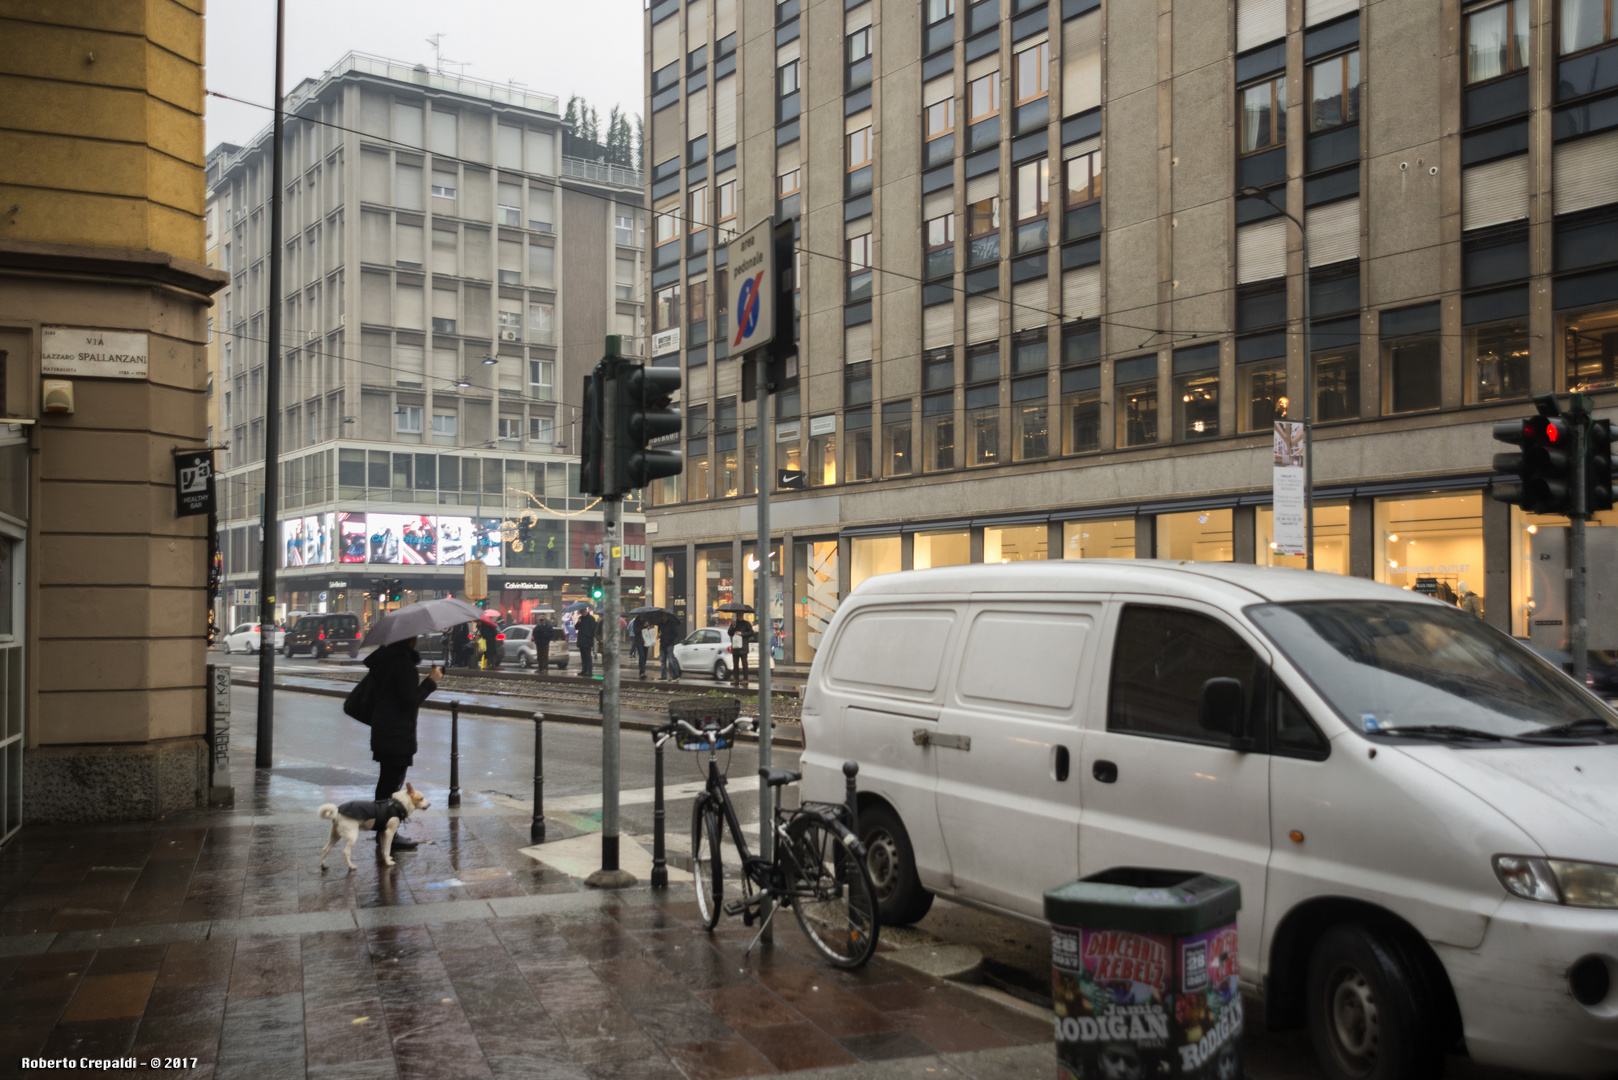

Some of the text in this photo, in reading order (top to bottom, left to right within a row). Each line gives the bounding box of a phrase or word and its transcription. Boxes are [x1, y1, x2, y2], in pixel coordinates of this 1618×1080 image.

[741, 236, 755, 252] area
[734, 251, 763, 280] pedonale
[86, 338, 104, 346] VIA
[78, 352, 147, 364] SPALLANZANI
[184, 494, 209, 503] HEALTHY
[1386, 564, 1470, 575] TEMPORARY OUTLET
[504, 582, 548, 590] Calvin Klein Jeans
[1052, 935, 1077, 952] 28
[1085, 930, 1165, 964] DANCEHALL
[1053, 953, 1078, 967] 2017
[1187, 954, 1205, 970] 28
[1094, 957, 1165, 991] REBELZ
[1104, 1003, 1163, 1016] Jamie
[1178, 1000, 1243, 1073] RODIGAN
